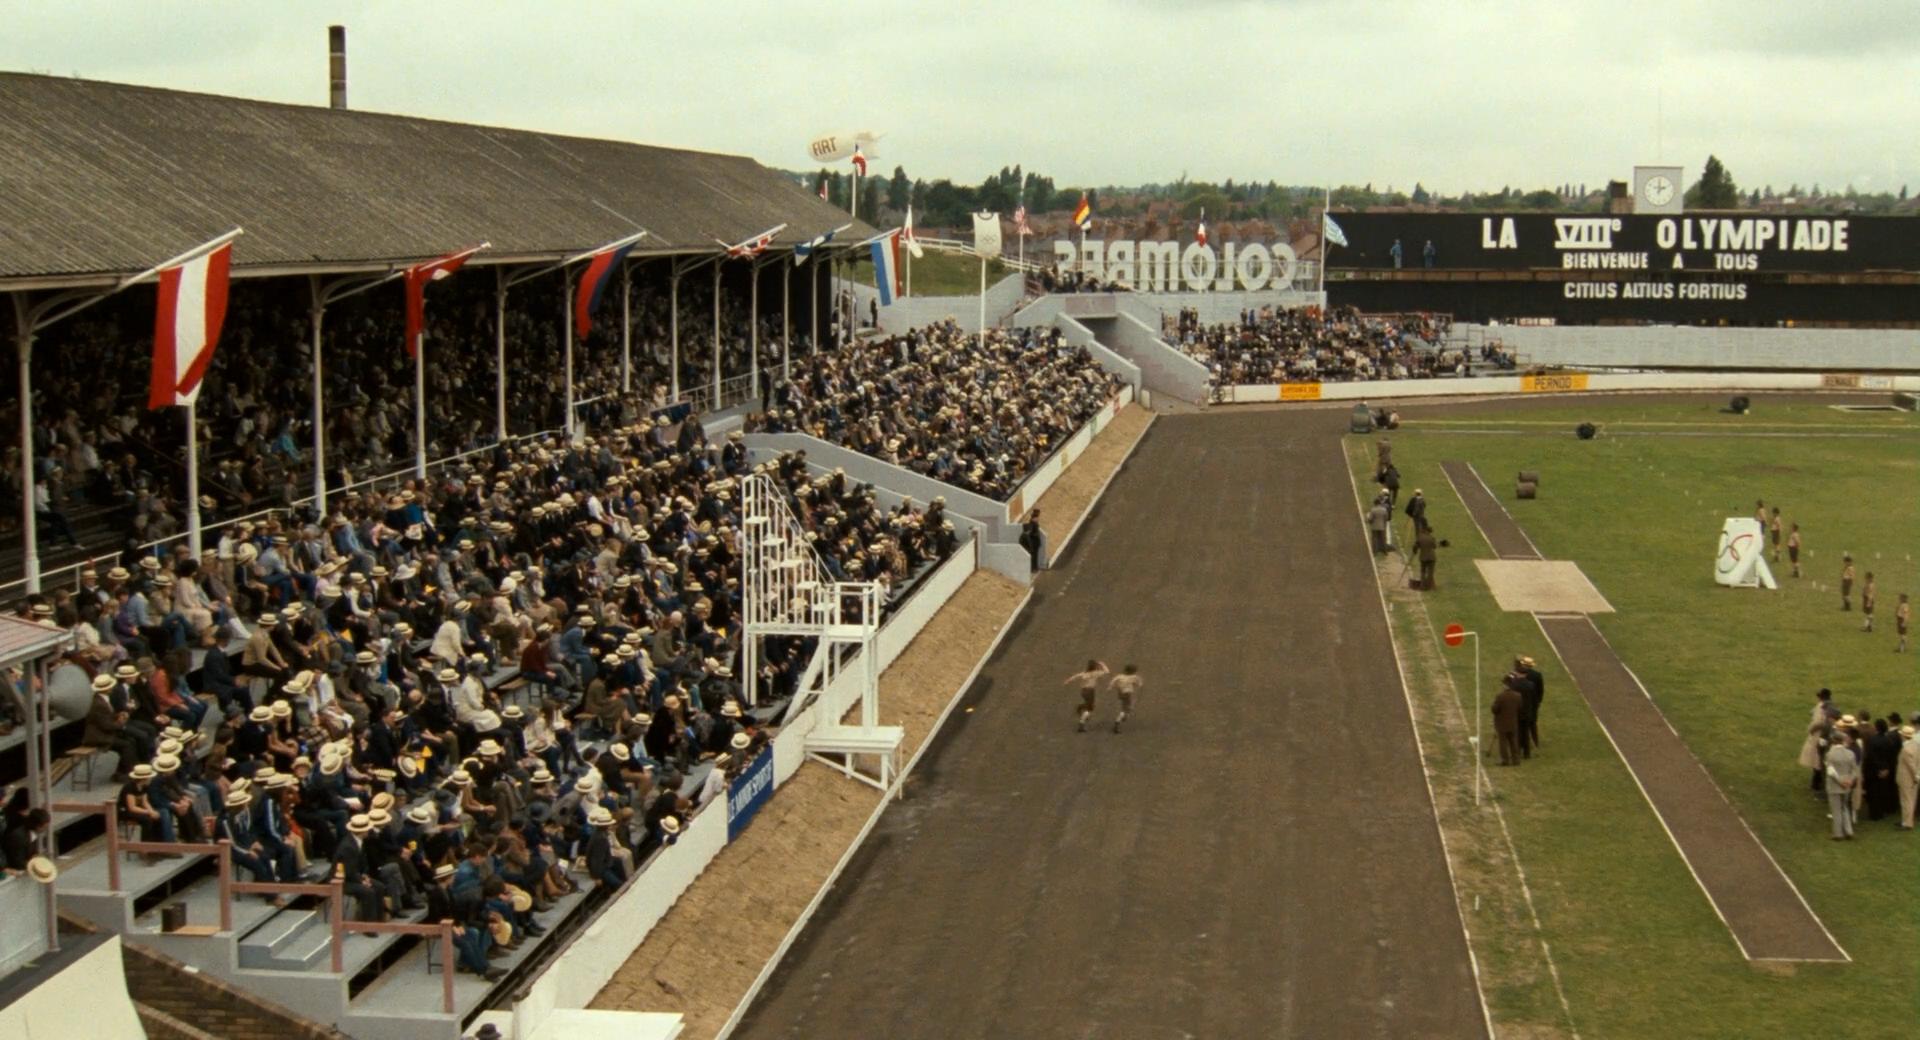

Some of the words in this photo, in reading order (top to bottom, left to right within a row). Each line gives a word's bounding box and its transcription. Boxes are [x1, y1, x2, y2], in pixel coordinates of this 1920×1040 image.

[812, 137, 836, 156] FIAT
[1482, 218, 1517, 249] LA
[1656, 218, 1849, 251] OLYMPIADE
[1562, 251, 1649, 269] BIENVENUE
[1673, 254, 1684, 269] A
[1715, 252, 1759, 270] TOUS
[1564, 282, 1617, 300] CITIUS
[1622, 282, 1674, 300] ALTIUS
[1678, 282, 1747, 301] FORTIUS
